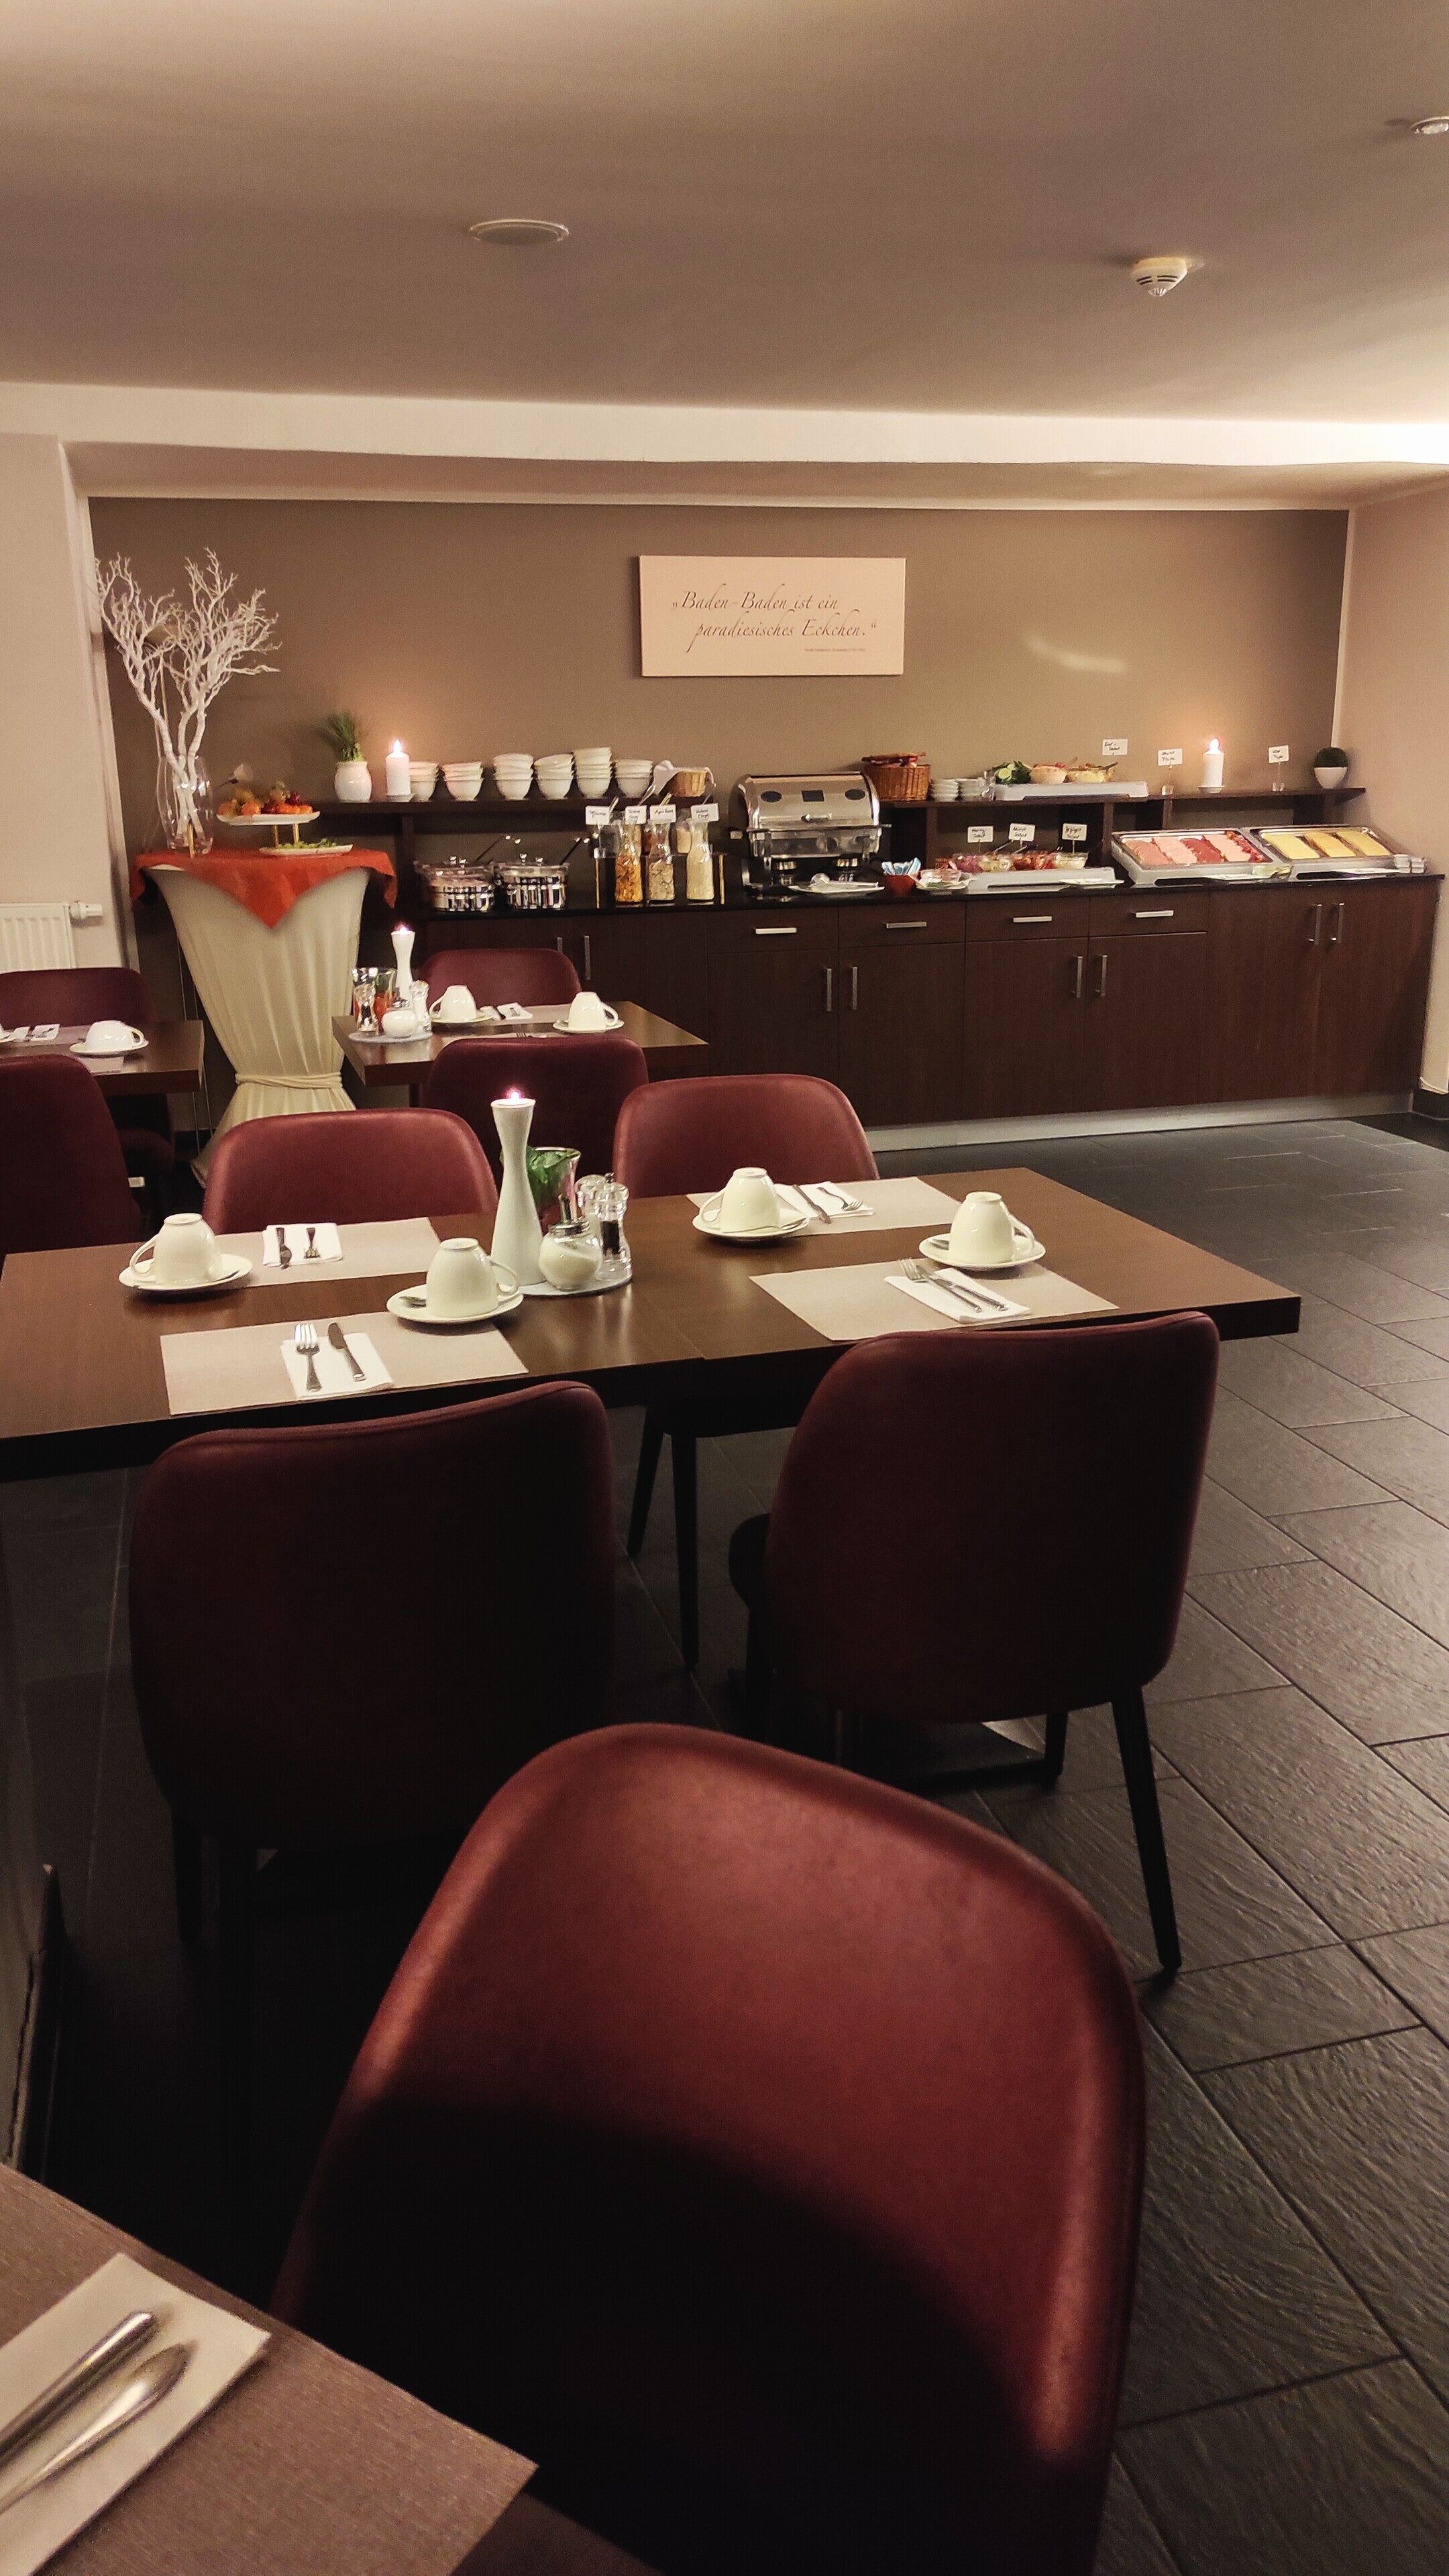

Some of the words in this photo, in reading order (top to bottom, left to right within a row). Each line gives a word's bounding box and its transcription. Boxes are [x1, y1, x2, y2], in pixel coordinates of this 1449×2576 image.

[794, 594, 813, 609] ist
[818, 594, 838, 609] ein
[686, 608, 795, 653] paradiesisches
